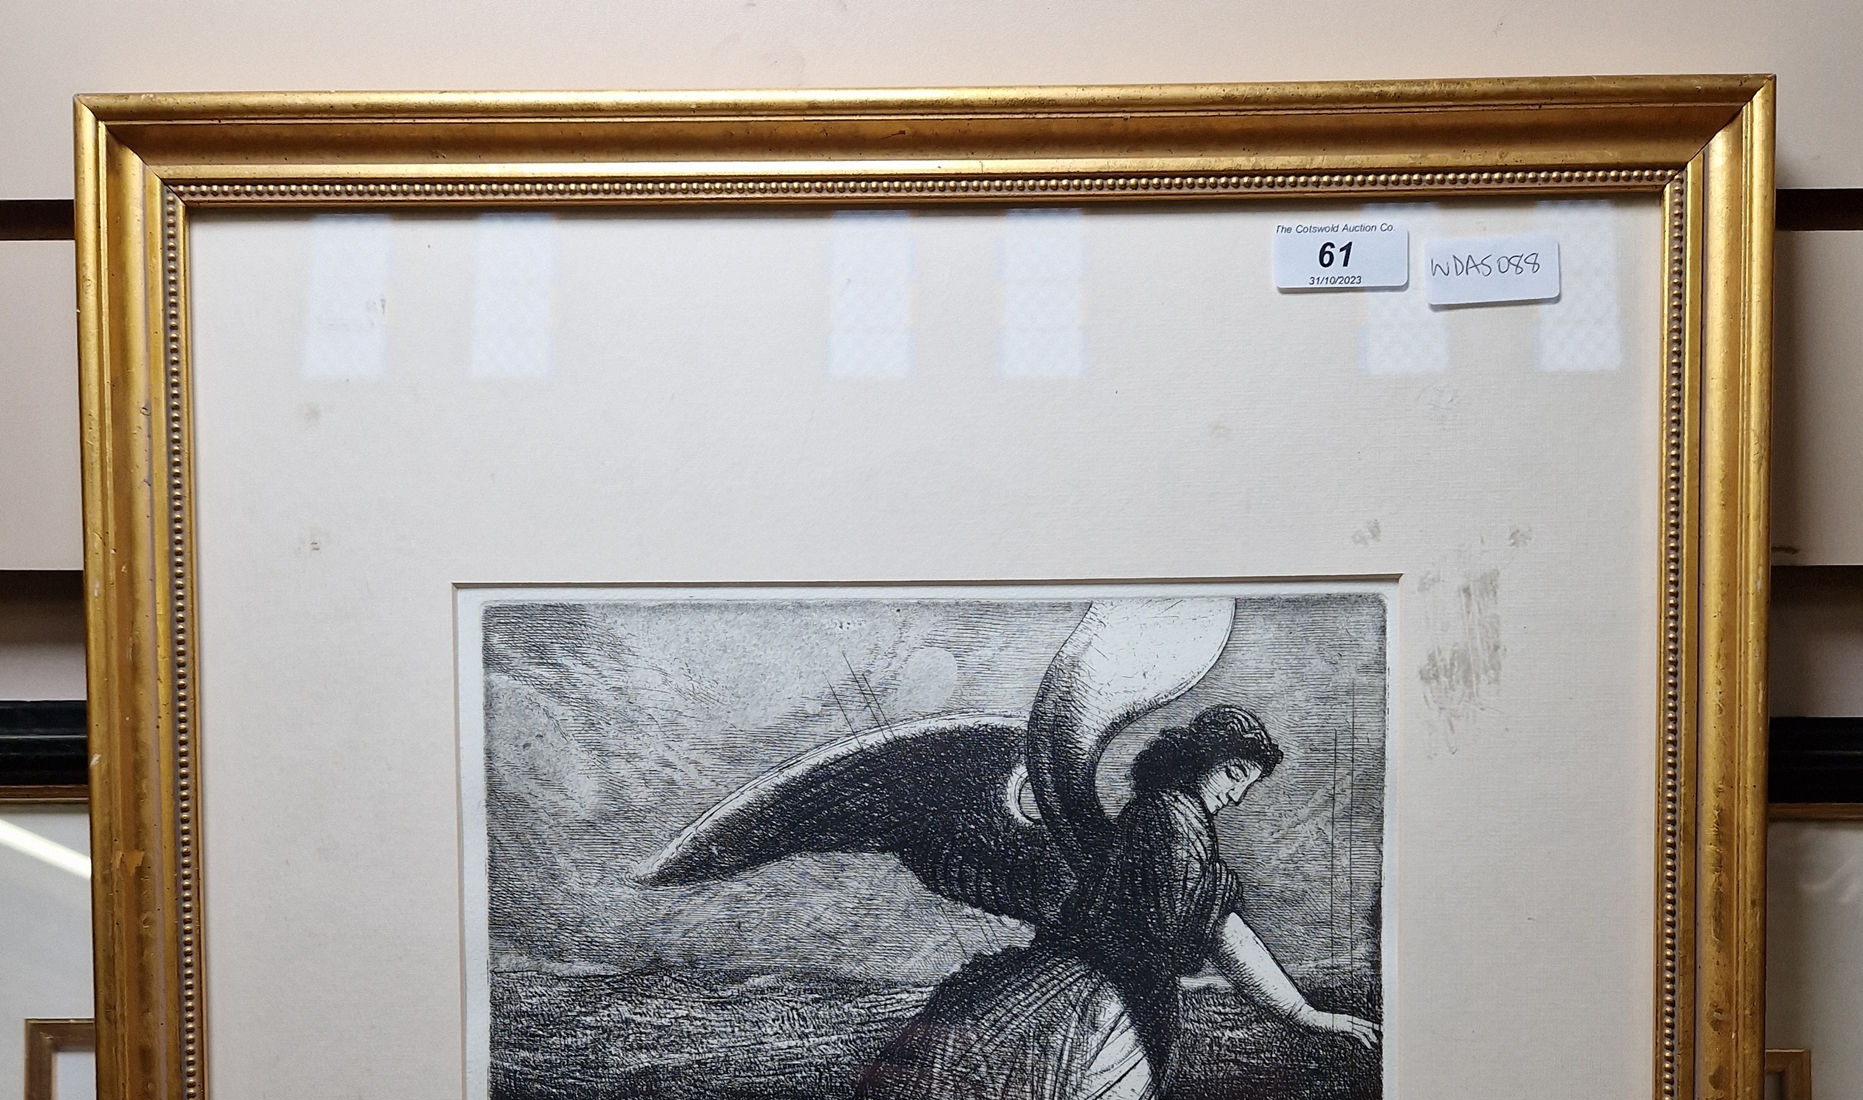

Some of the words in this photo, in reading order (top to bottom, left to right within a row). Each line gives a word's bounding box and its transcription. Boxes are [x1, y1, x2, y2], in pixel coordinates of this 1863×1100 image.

[1275, 224, 1293, 234] The
[1295, 224, 1340, 234] Cotswold
[1342, 223, 1377, 232] Auction
[1379, 223, 1396, 232] Co.
[1318, 241, 1353, 268] 61
[1308, 275, 1362, 286] 31/10/2023
